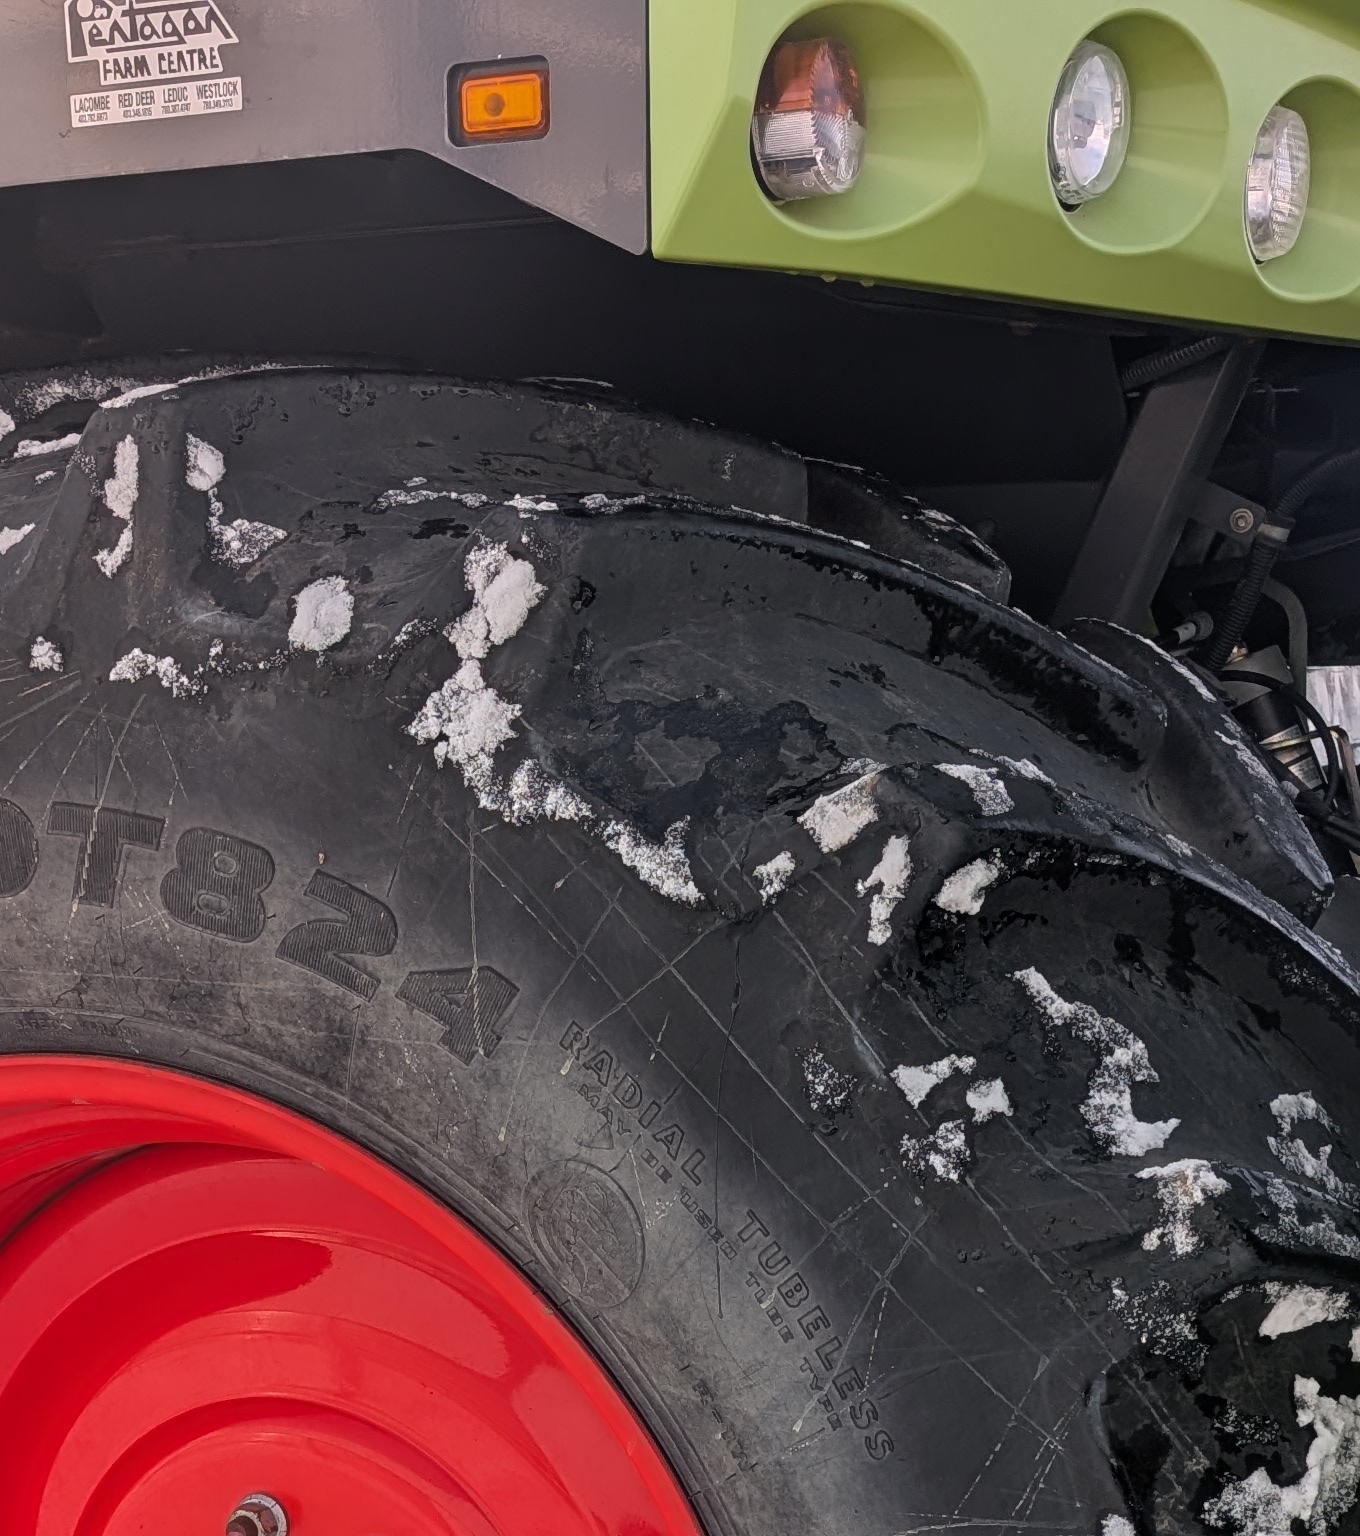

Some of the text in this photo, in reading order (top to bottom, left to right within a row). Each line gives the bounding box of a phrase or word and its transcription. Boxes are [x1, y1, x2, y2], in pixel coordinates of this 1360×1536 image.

[103, 46, 219, 81] FARM CENTRE
[73, 80, 238, 113] LACOMBE RED DEER LEDUC WESTLOCK
[577, 1083, 631, 1137] MAY
[559, 1020, 895, 1461] RADIAL TUBELESS
